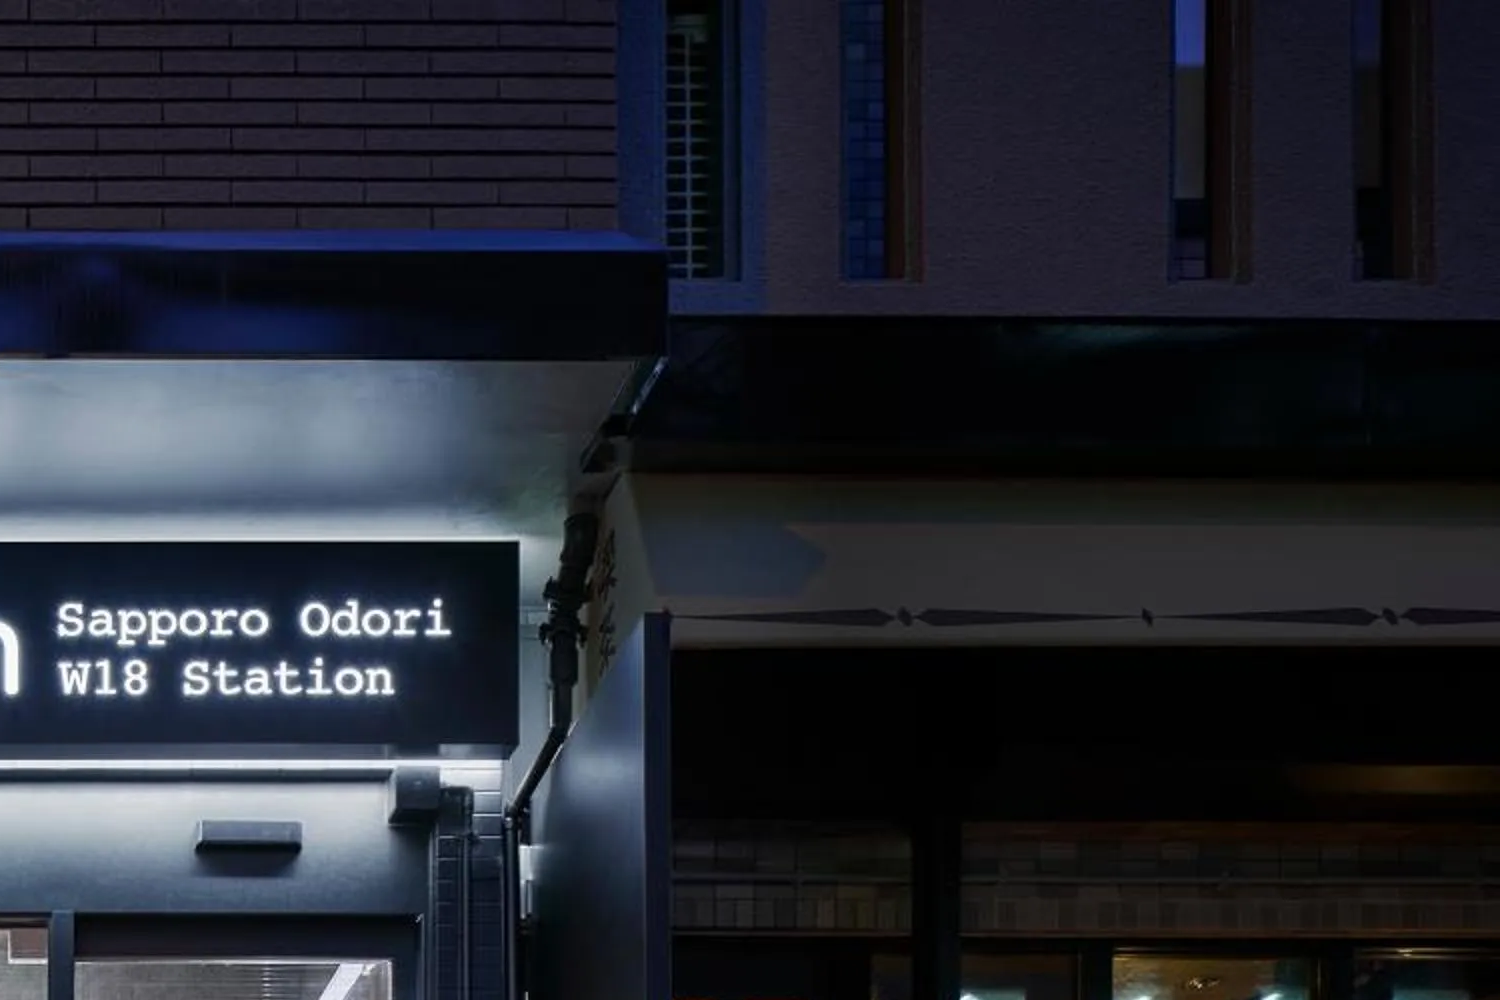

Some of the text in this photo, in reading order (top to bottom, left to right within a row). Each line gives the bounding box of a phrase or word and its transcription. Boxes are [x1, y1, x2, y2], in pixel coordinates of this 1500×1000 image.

[56, 598, 452, 646] Sapporo Odori
[56, 657, 396, 696] W18 Station
